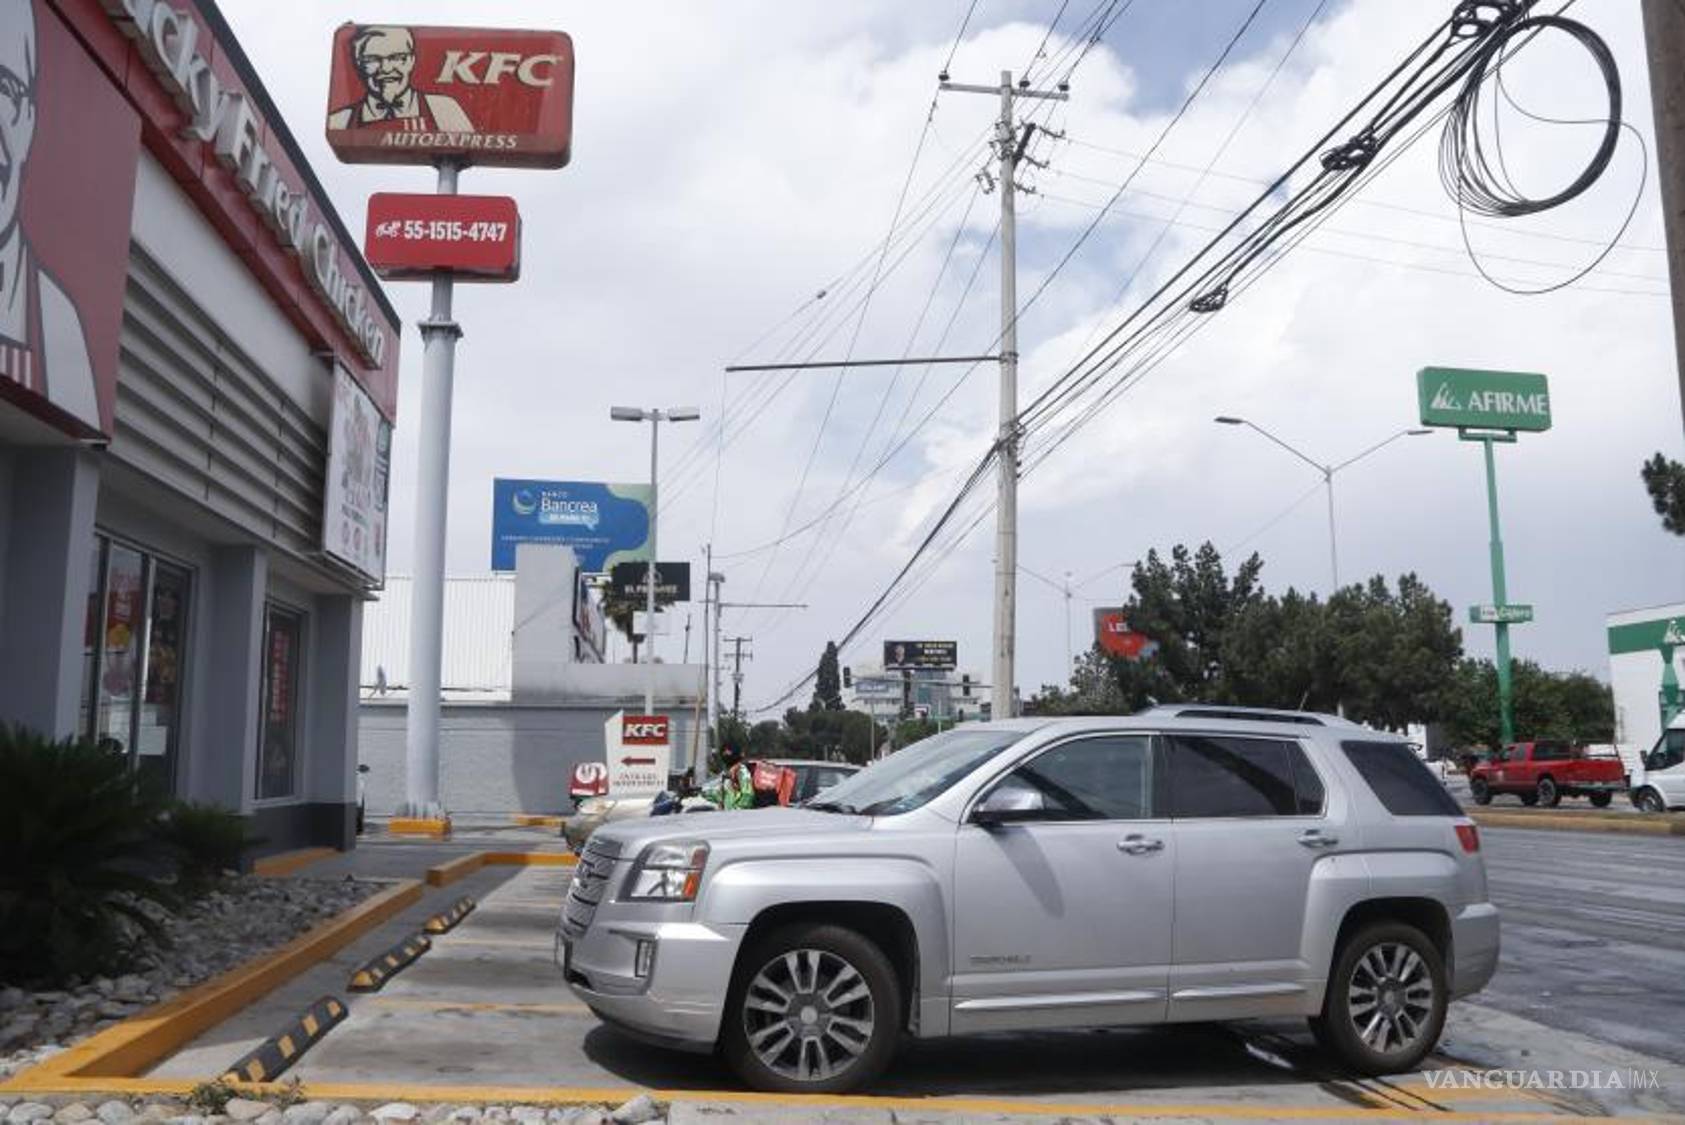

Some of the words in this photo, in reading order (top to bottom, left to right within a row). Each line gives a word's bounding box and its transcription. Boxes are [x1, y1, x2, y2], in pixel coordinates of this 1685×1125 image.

[434, 50, 564, 88] KFC
[380, 131, 518, 150] AUTOEXPRESS
[216, 93, 309, 257] Fried
[312, 222, 384, 368] Chicken
[403, 219, 508, 242] 55-1515-4747
[1467, 390, 1549, 415] AFIRME
[541, 498, 598, 513] Bancrea
[624, 723, 667, 738] KFC
